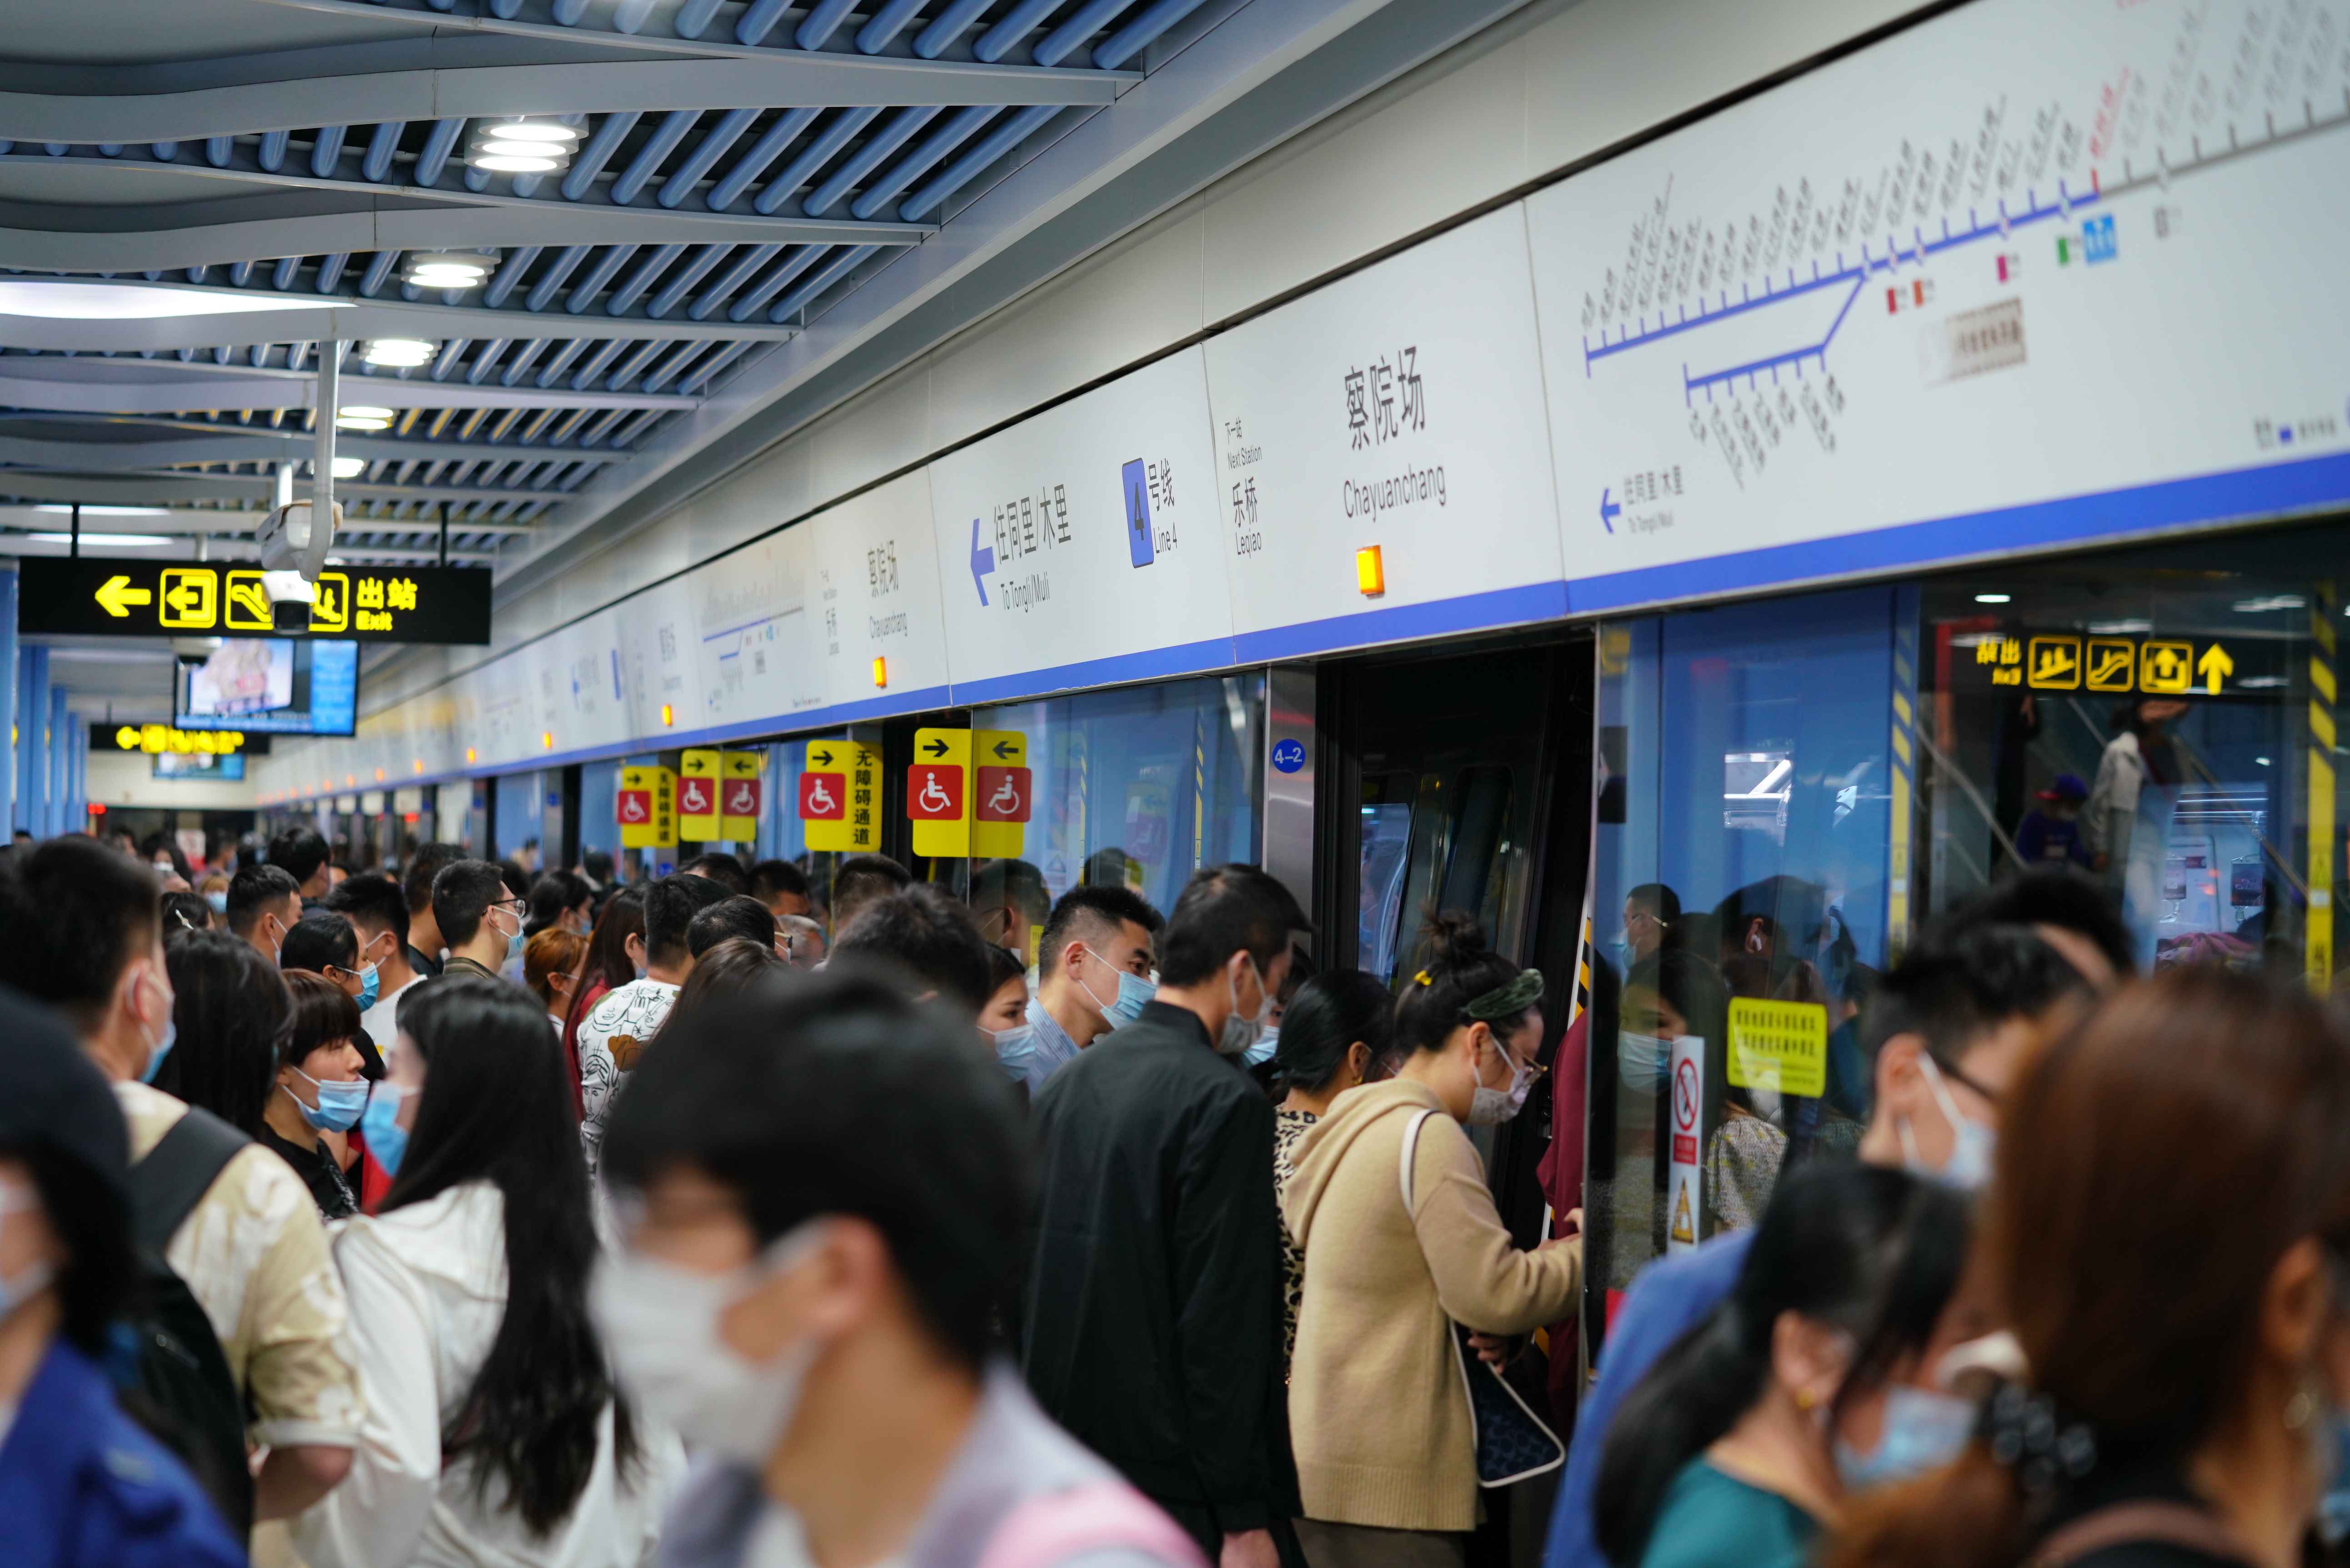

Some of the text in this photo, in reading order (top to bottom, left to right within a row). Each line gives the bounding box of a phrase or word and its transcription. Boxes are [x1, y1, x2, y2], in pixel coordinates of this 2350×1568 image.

[1344, 346, 1425, 451] 察院场
[1225, 416, 1242, 444] 下一站
[1228, 444, 1262, 470] Next Station
[1232, 476, 1258, 528] 乐桥
[1344, 464, 1446, 523] Chayuanchang
[1624, 464, 1684, 505] 往同里木里
[993, 483, 1072, 565] 往同里/木里
[1153, 522, 1178, 554] Line 4
[1235, 528, 1262, 559] Leqiao
[868, 540, 899, 598] 察院场
[357, 577, 418, 610] 出站
[1000, 571, 1050, 613] To Tongli/Muli
[356, 610, 393, 631] Exit
[869, 609, 908, 643] Chayuanchang
[1274, 747, 1303, 764] 4-2
[854, 749, 873, 845] 无障碍通道
